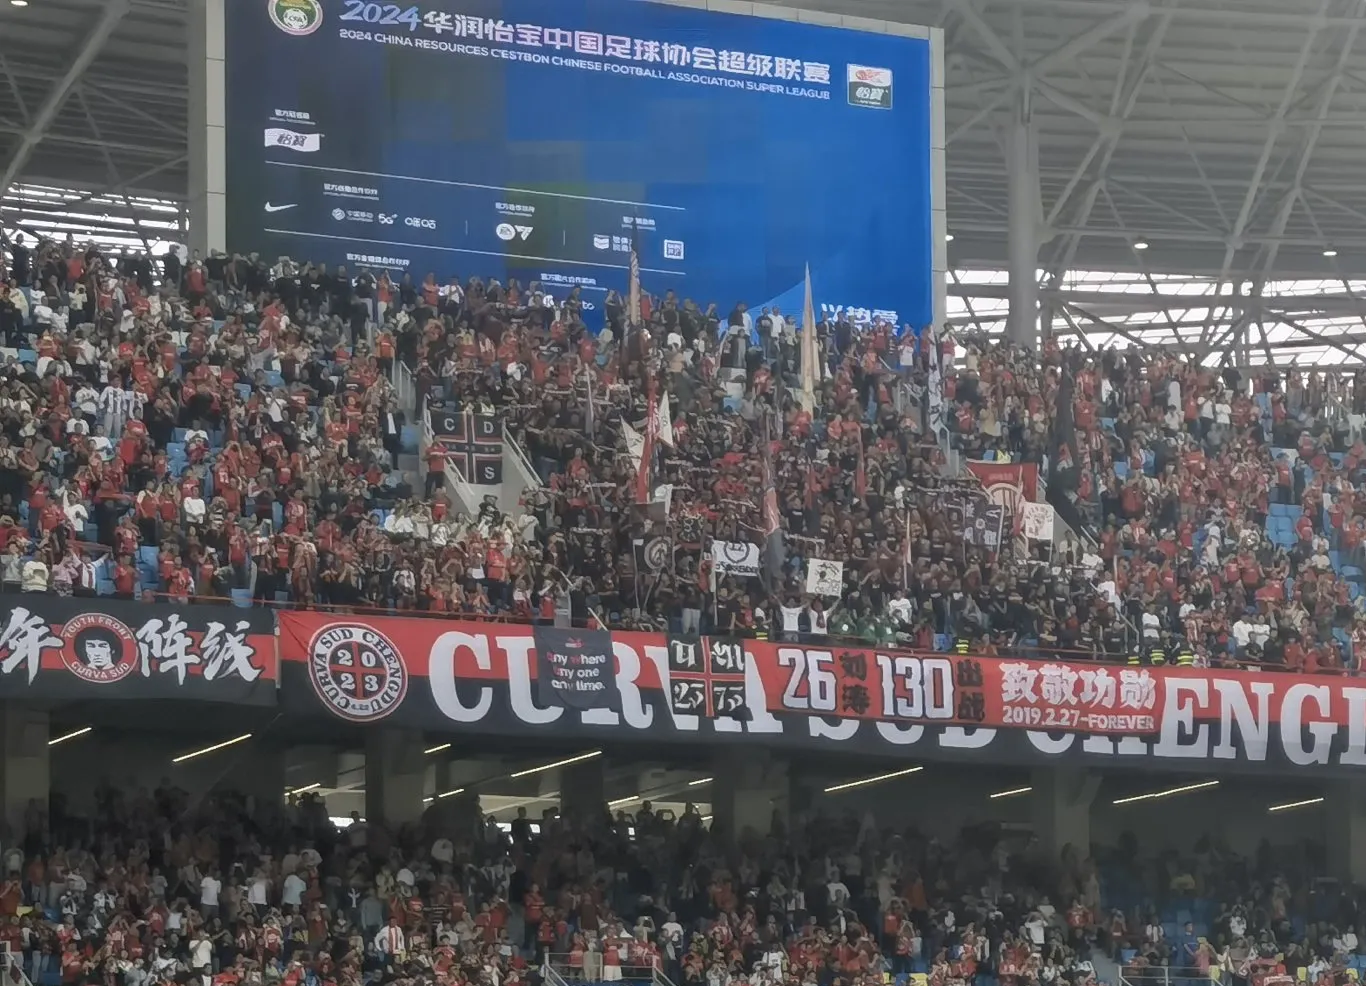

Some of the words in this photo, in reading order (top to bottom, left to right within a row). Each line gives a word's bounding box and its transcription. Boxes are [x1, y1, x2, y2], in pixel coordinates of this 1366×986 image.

[339, 28, 372, 41] 2024
[373, 32, 413, 48] CHINA
[414, 38, 489, 57] RESOURCES
[551, 55, 602, 72] CHINESE
[603, 62, 667, 80] FOOTBALL
[667, 71, 745, 90] ASSOCIATION
[745, 81, 785, 95] SUPER
[785, 86, 831, 100] LEAGUE
[63, 615, 95, 639] YOUTH
[99, 615, 133, 641] FRONT
[136, 613, 265, 686] 阵线
[320, 628, 354, 649] SUD
[70, 660, 108, 680] CURVA
[111, 661, 130, 679] SUD
[315, 652, 351, 709] CURVA
[361, 631, 402, 713] CHENGDU
[576, 668, 600, 678] one
[778, 648, 837, 712] 26
[876, 655, 956, 720] 130
[999, 662, 1157, 710] 致敬功勋
